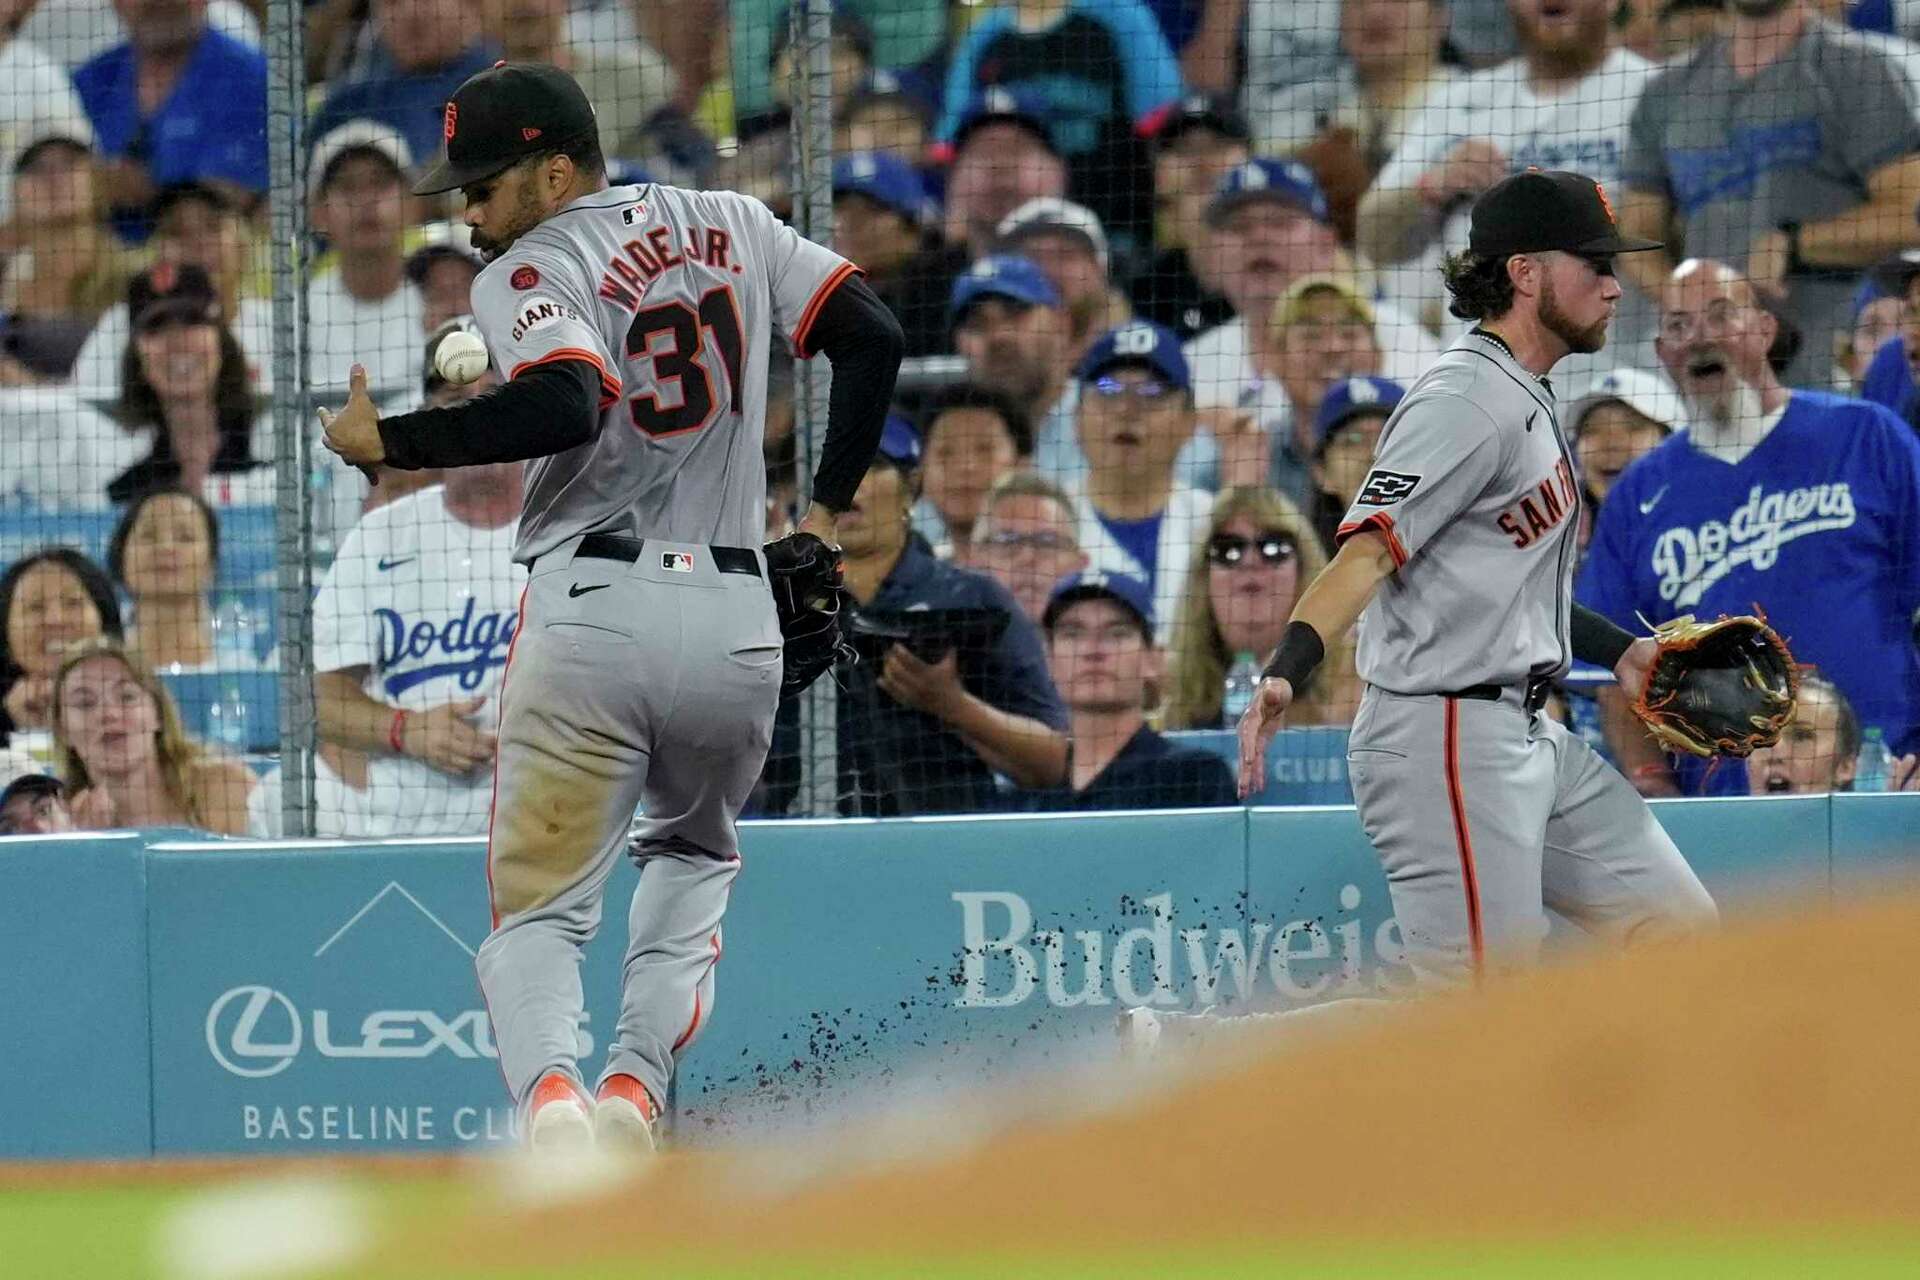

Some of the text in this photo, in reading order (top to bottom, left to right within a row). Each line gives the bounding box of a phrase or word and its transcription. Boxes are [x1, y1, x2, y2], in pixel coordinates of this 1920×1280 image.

[598, 226, 744, 314] WADE JR.
[512, 303, 577, 342] GIANTS
[625, 282, 746, 441] 31
[1496, 478, 1563, 549] SAN
[1651, 483, 1856, 602] Dodgers
[244, 1105, 435, 1141] BASELINE
